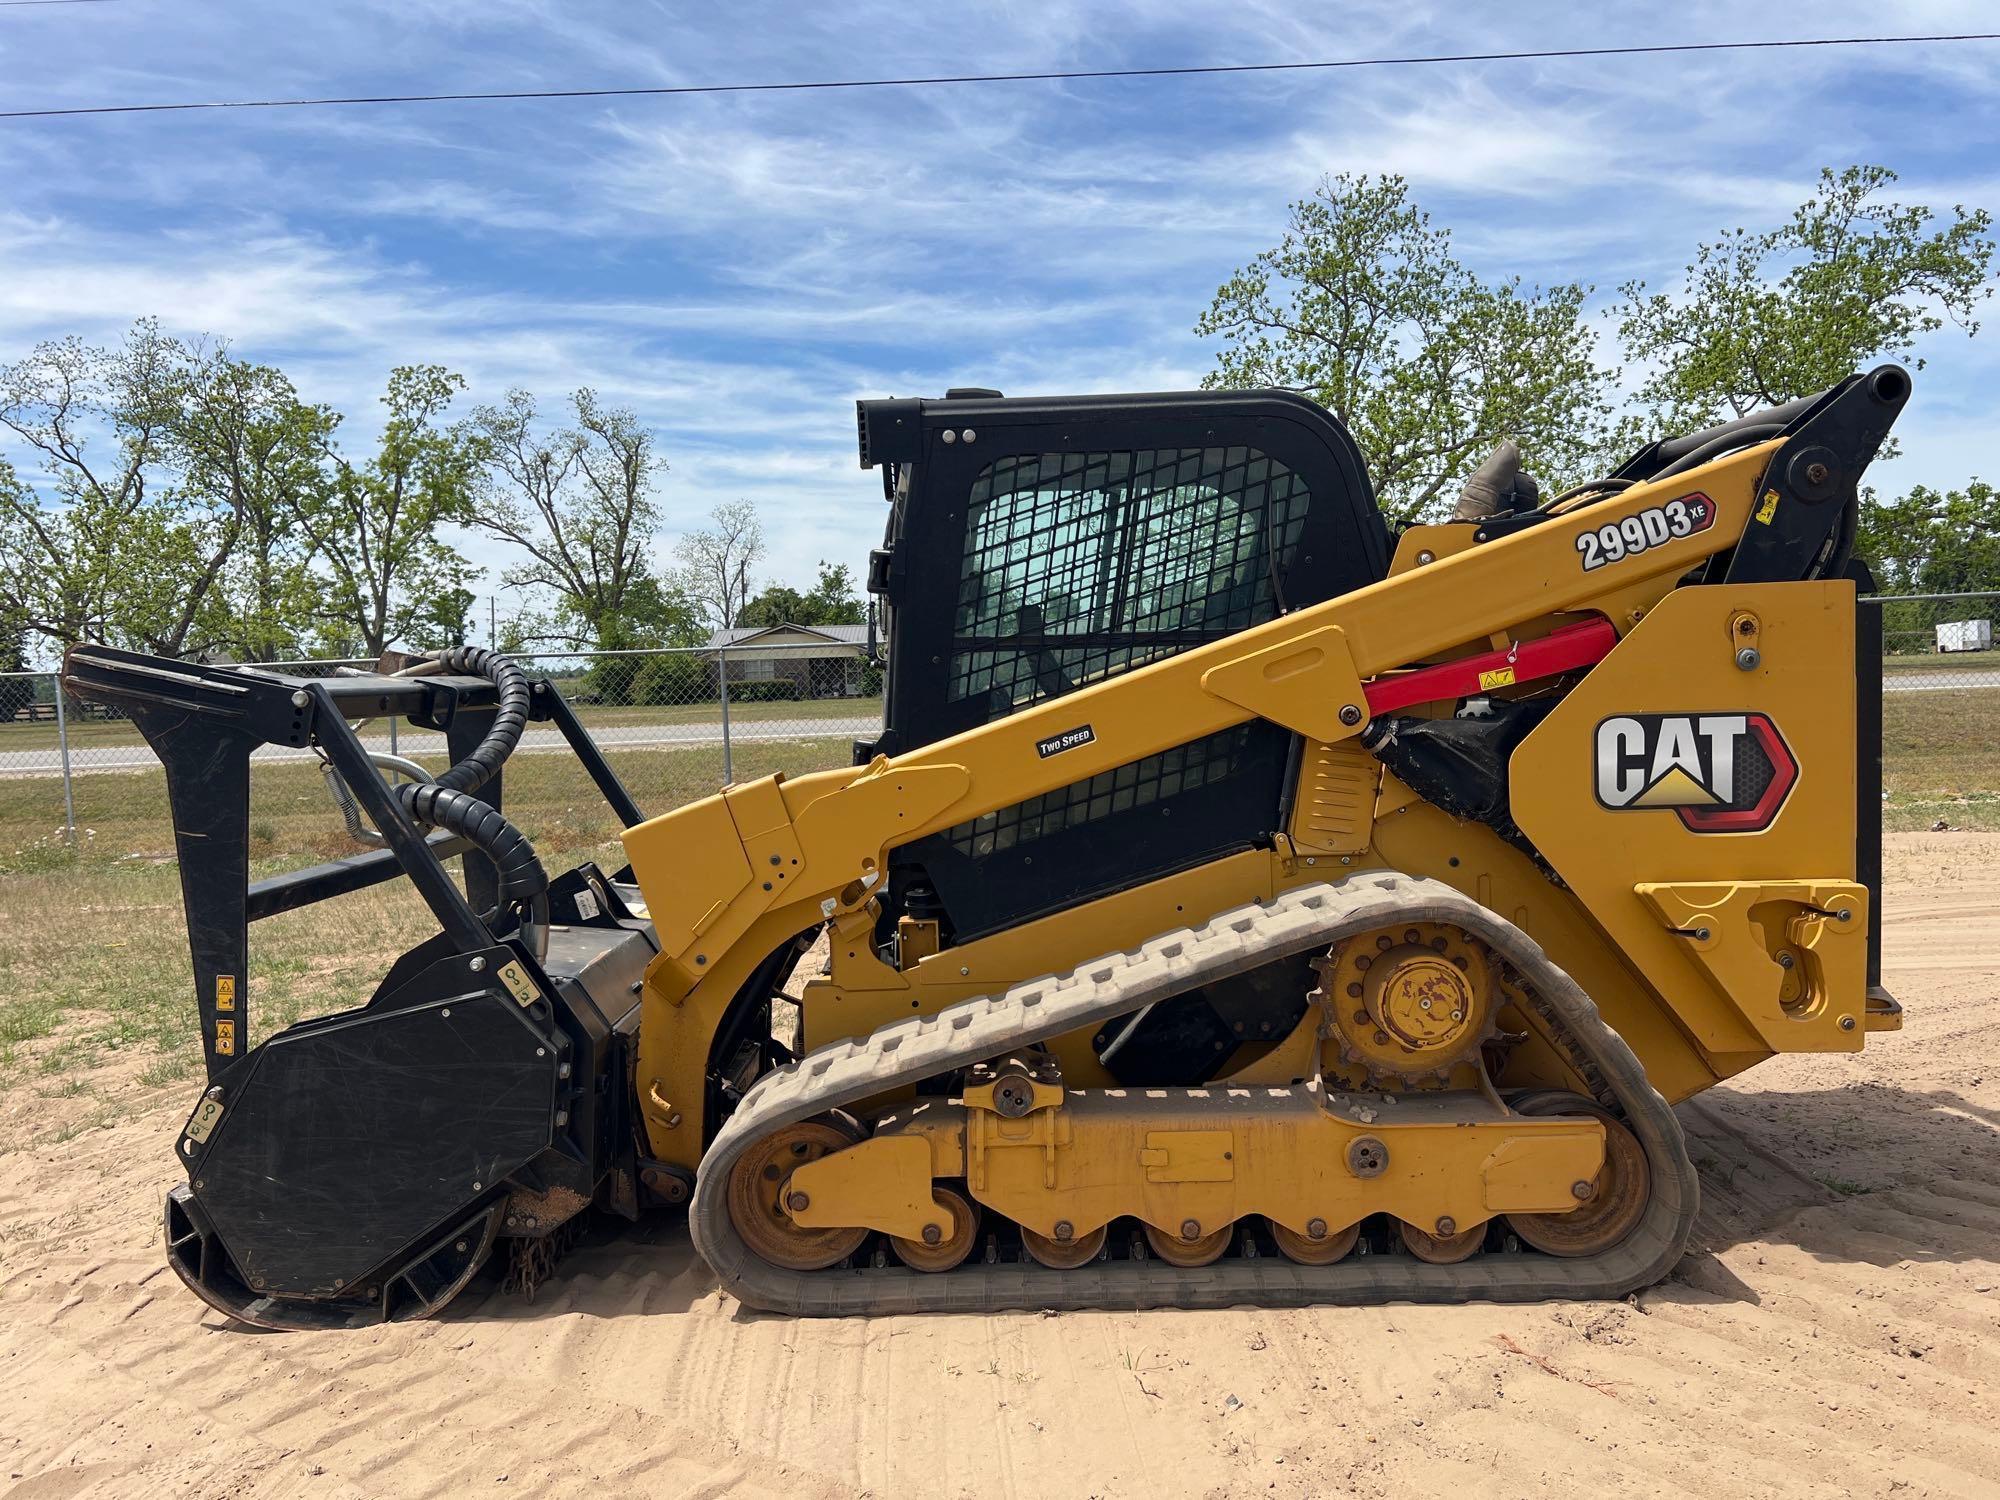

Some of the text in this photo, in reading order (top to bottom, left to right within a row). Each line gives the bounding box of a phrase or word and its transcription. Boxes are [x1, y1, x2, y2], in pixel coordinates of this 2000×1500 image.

[1577, 501, 1705, 570] 299D3 XE
[1597, 716, 1746, 806] CAT
